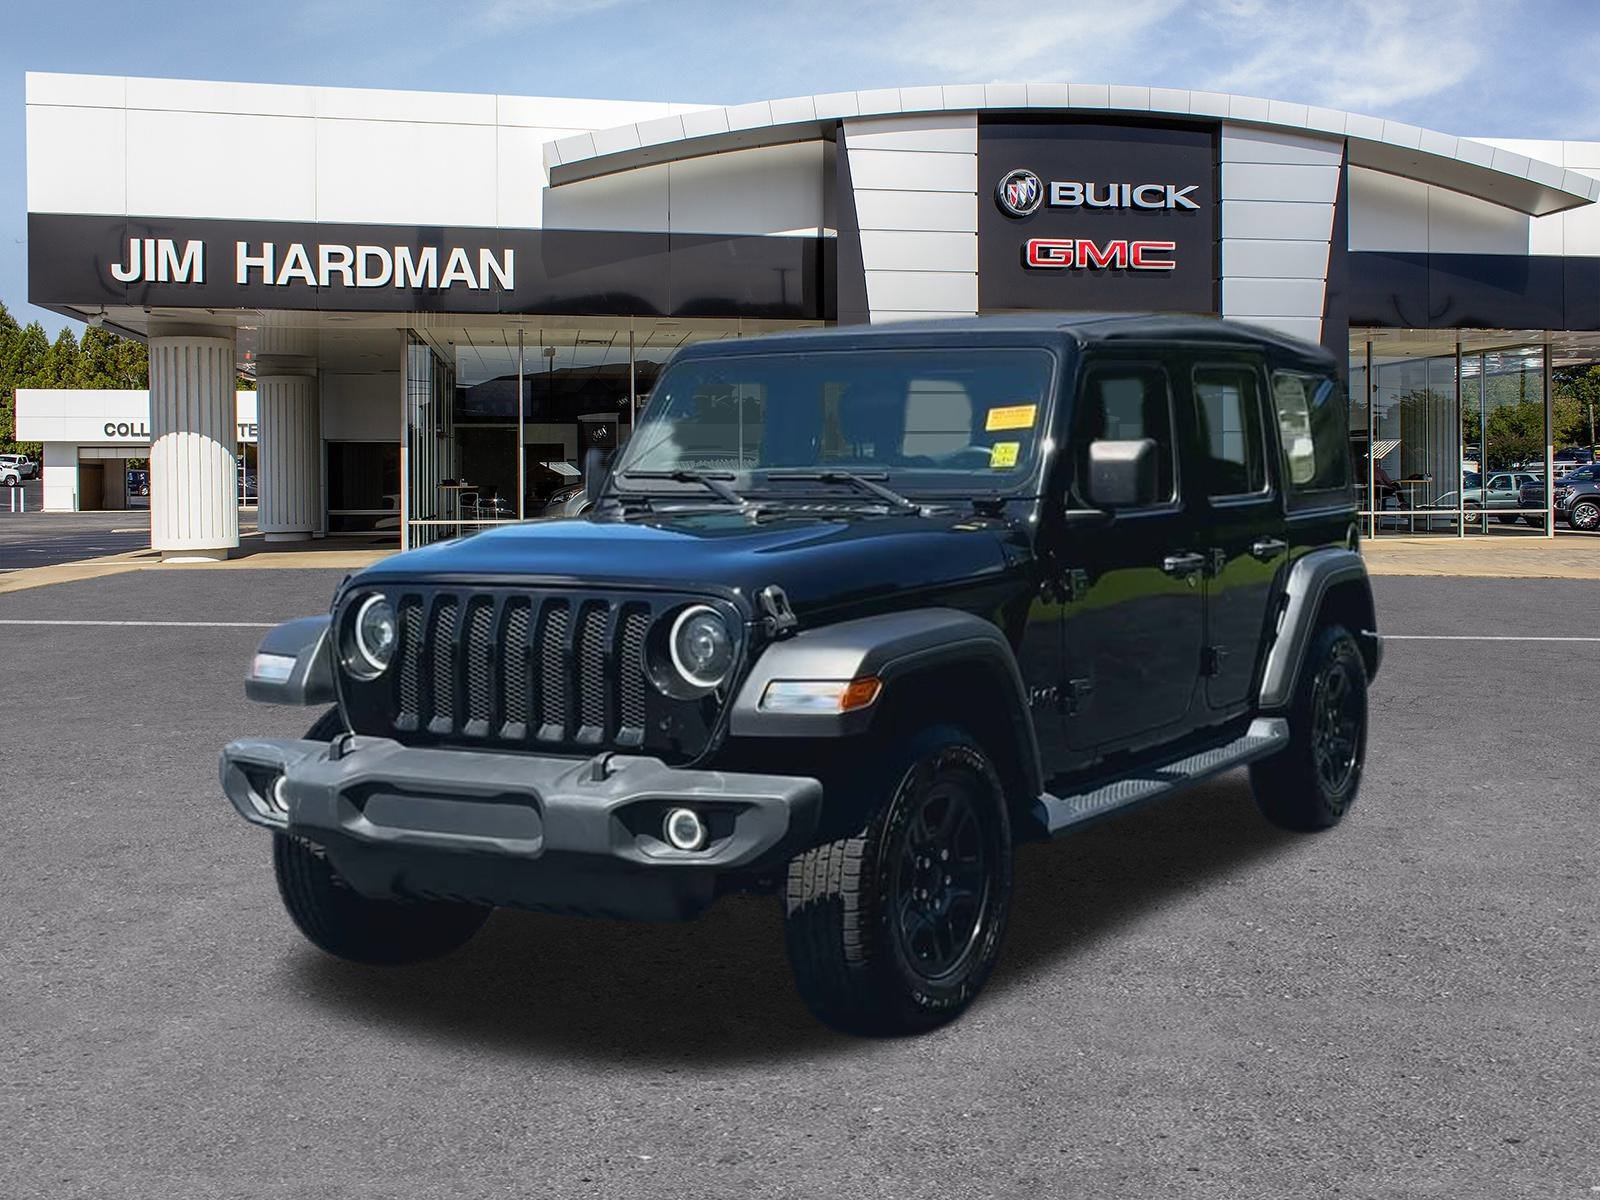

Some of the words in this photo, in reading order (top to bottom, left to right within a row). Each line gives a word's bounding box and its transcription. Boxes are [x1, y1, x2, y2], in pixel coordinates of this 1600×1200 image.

[1050, 181, 1201, 209] BUICK
[110, 238, 205, 283] JIM
[236, 240, 515, 291] HARDMAN
[1026, 238, 1176, 270] GMC
